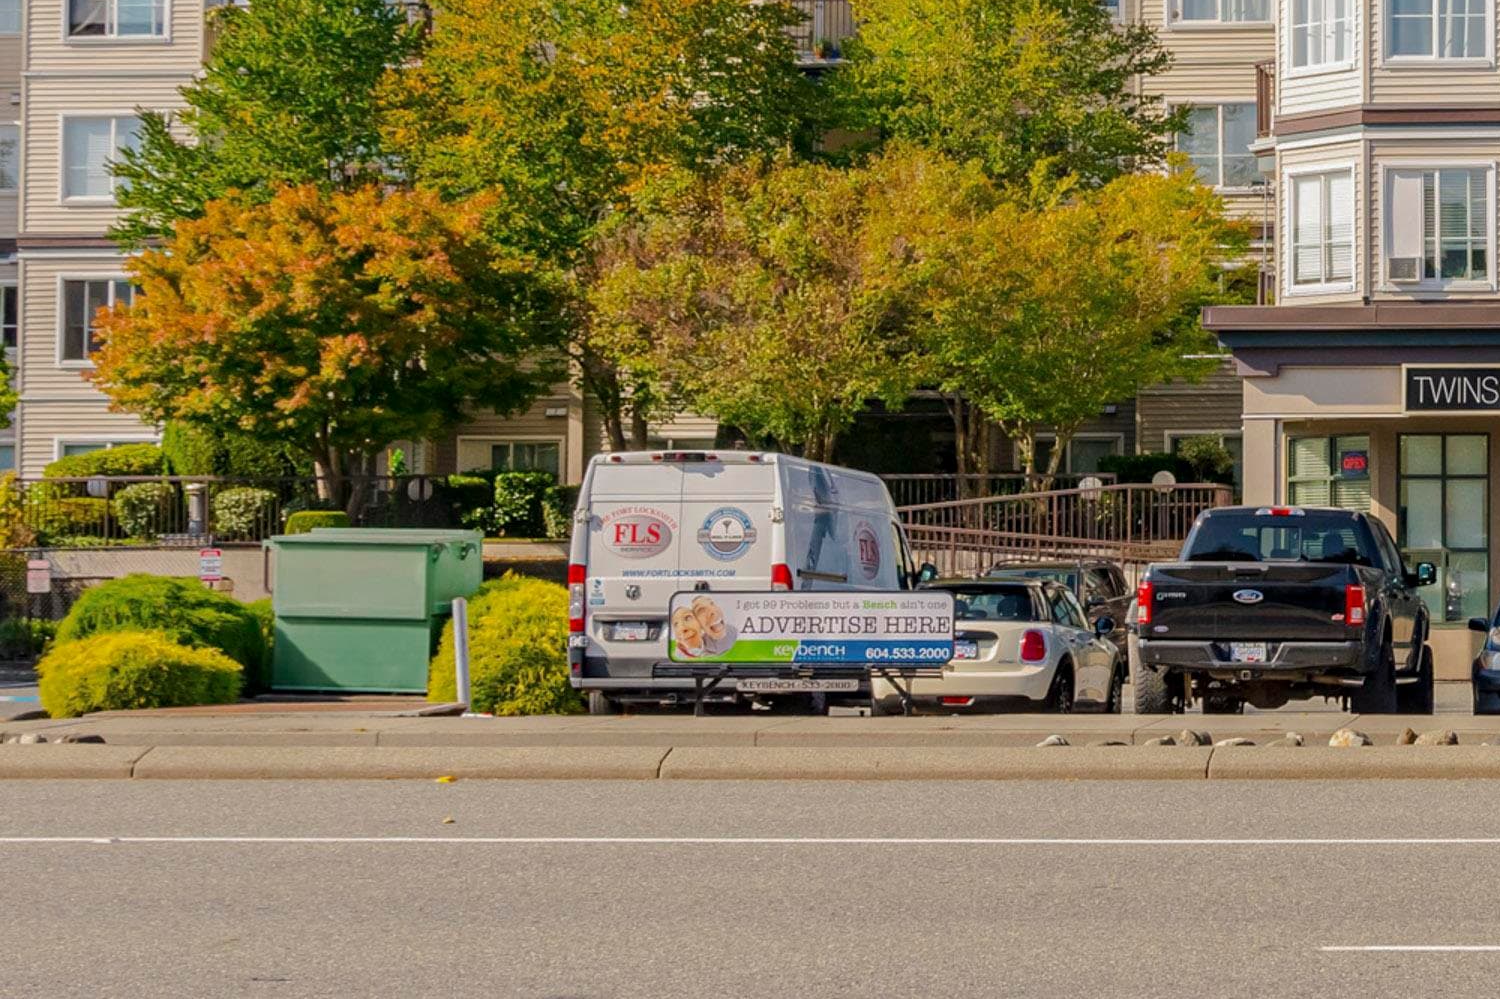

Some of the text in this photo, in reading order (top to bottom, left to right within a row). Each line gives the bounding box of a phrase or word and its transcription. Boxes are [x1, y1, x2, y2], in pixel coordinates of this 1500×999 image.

[614, 522, 661, 544] FLS
[859, 538, 876, 562] FLS
[622, 569, 736, 577] WWW.FORTLOCKSMITH.COM
[736, 600, 741, 610] I
[743, 600, 760, 611] got
[763, 600, 777, 609] 99
[780, 600, 830, 610] Problems
[832, 600, 850, 609] but
[863, 600, 897, 609] Bench
[900, 600, 924, 609] ain't
[927, 601, 947, 609] one
[740, 616, 950, 634] ADVERTISE HERE
[865, 647, 950, 659] 604.533.2000
[742, 680, 795, 689] KEYBENCH
